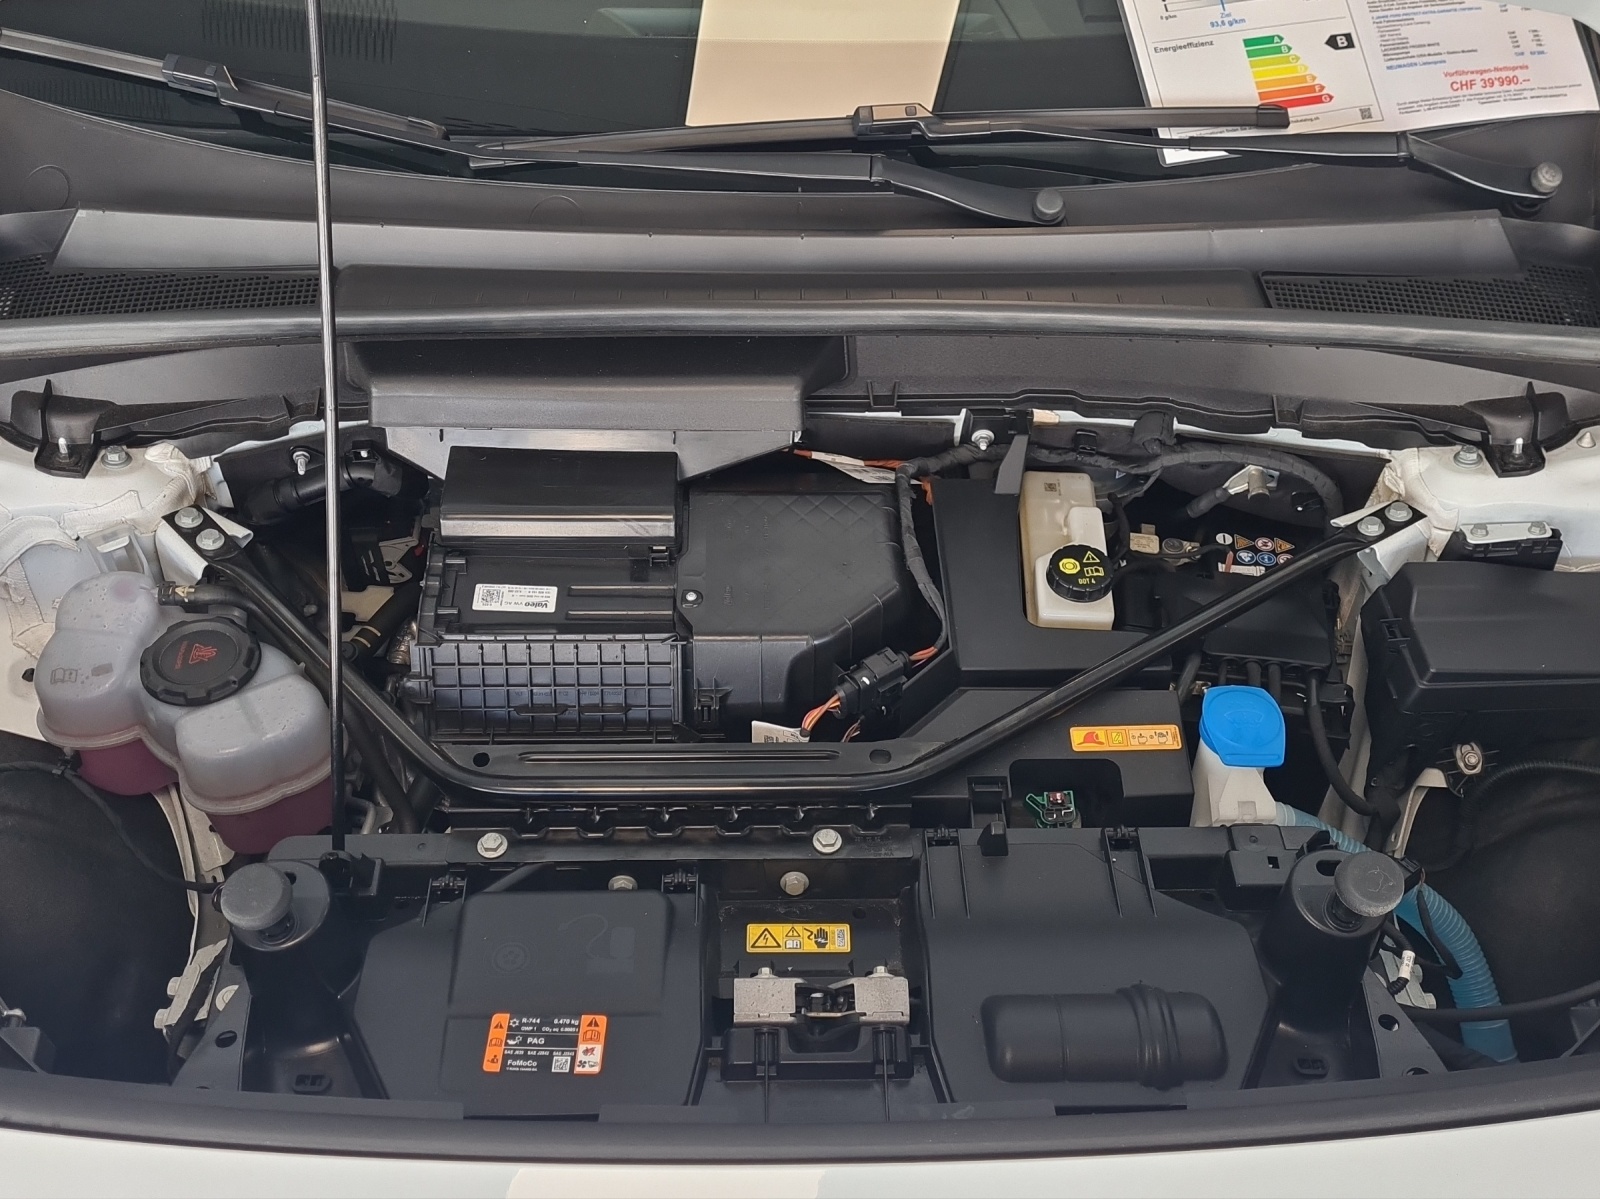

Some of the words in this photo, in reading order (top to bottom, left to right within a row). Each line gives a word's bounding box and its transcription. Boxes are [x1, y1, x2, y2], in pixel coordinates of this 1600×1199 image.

[1209, 19, 1226, 28] 93,6
[1227, 17, 1246, 27] g/km
[1273, 35, 1281, 43] A
[1336, 35, 1349, 47] B
[1153, 39, 1214, 54] Energieeffizienz
[1281, 45, 1289, 53] B
[1289, 55, 1297, 63] C
[1306, 74, 1314, 82] E
[1315, 84, 1322, 93] F
[1450, 80, 1477, 92] CHF
[1321, 94, 1330, 103] G
[527, 1037, 545, 1045] PAG
